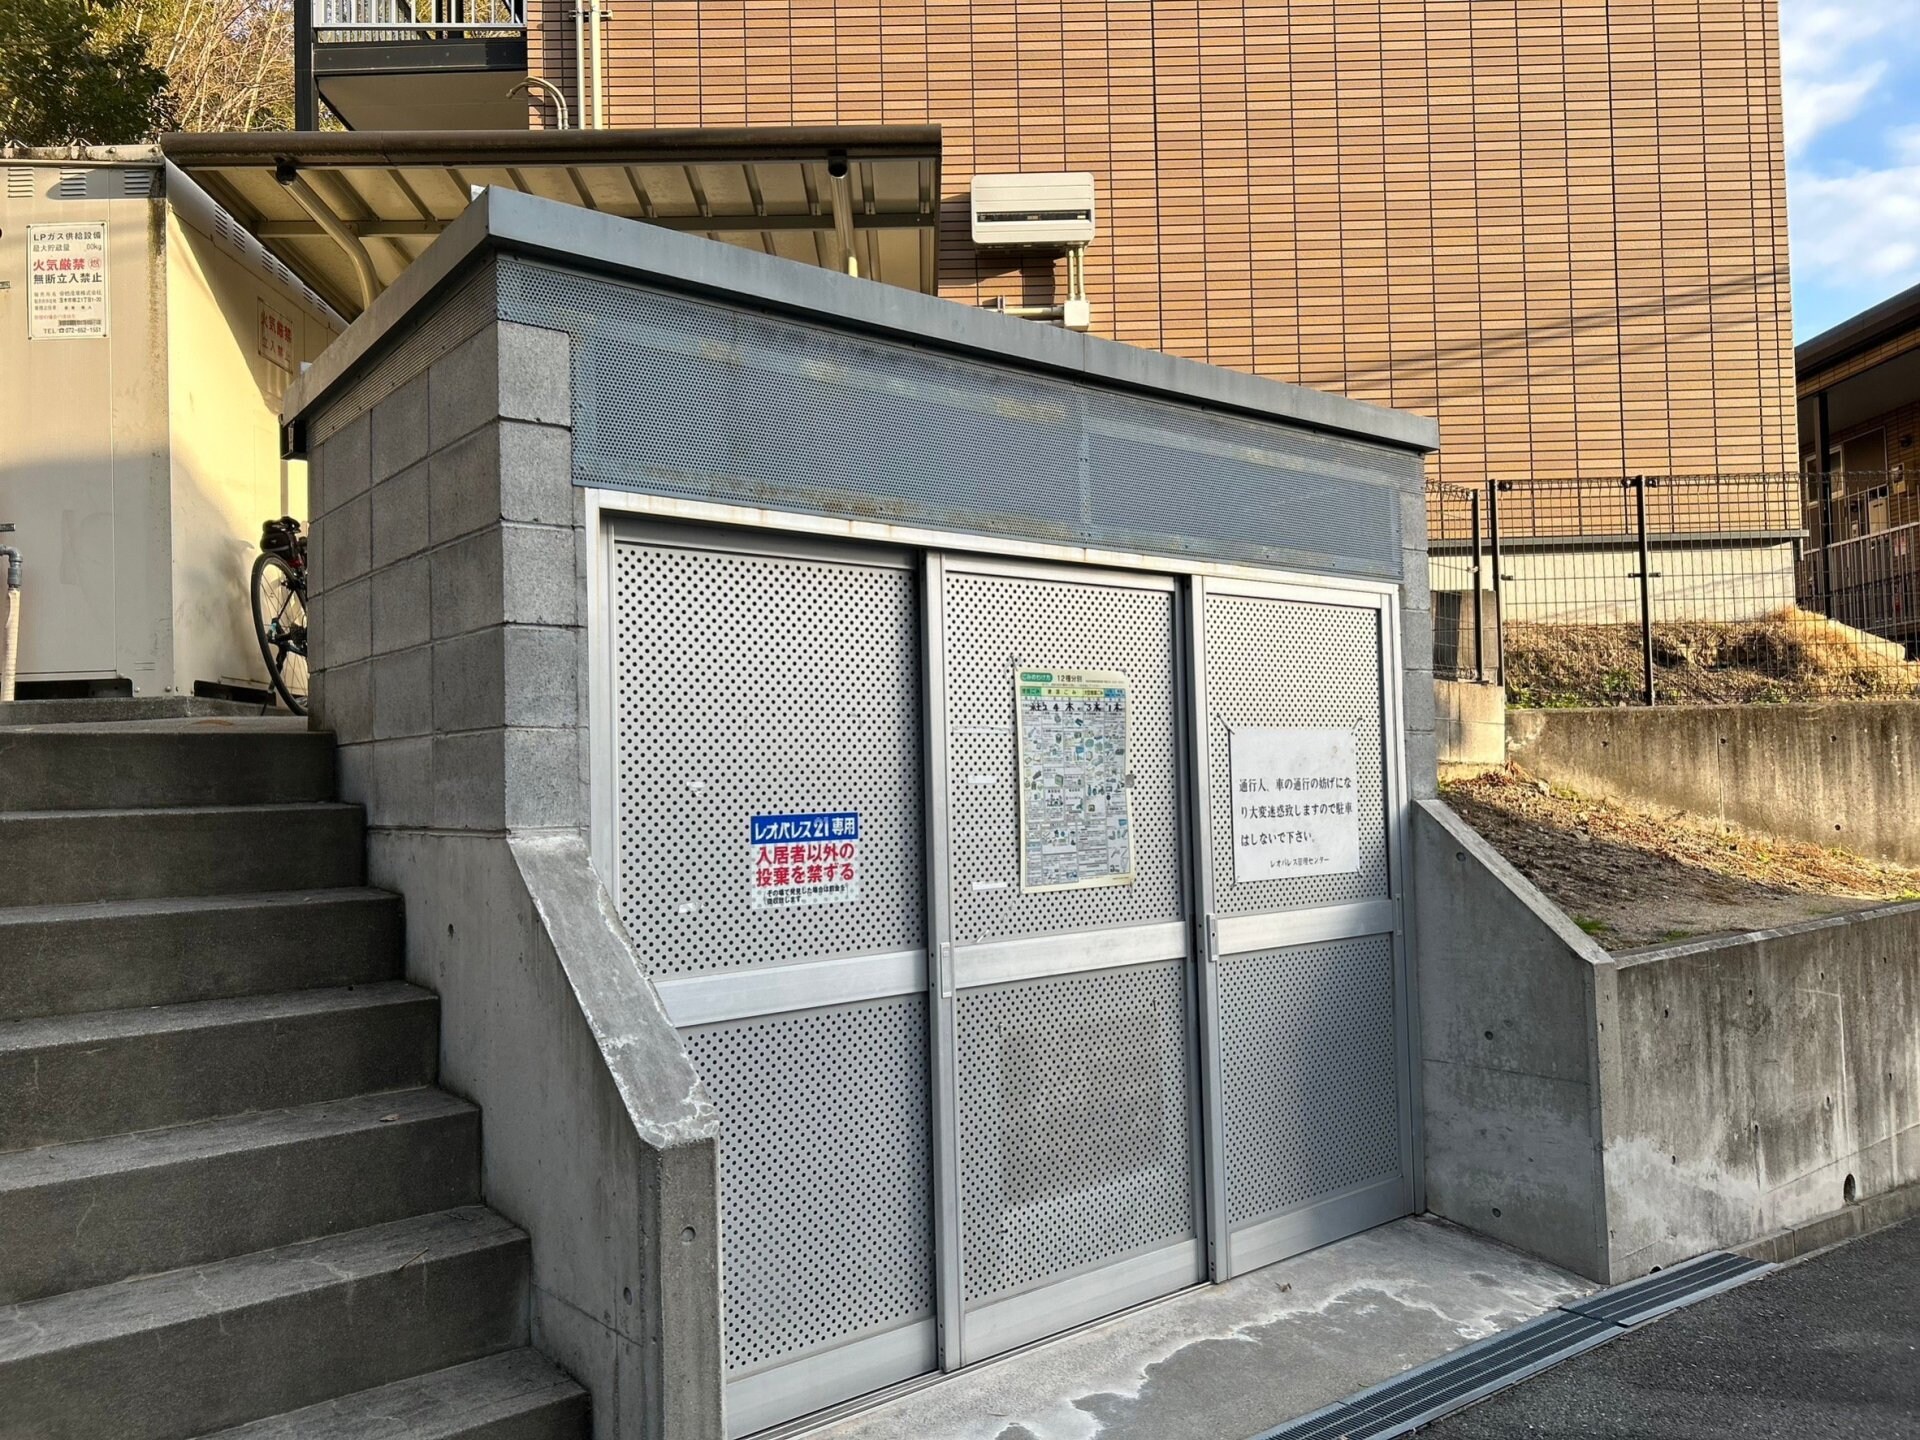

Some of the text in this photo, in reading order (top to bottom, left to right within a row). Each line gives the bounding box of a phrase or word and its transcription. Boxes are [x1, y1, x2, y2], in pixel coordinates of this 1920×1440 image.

[34, 232, 101, 241] LPガス供給設備
[33, 258, 85, 271] 火気厳禁
[33, 273, 102, 285] 無断立入禁止
[1057, 674, 1083, 683] 12種分別
[1241, 802, 1352, 819] り大変迷惑致しますので駐車
[1241, 831, 1315, 847] はしないで下さい。
[756, 842, 855, 866] 入居者以外の
[1270, 857, 1331, 868] レオパレス管理センター
[756, 863, 854, 886] 投棄を禁ずる
